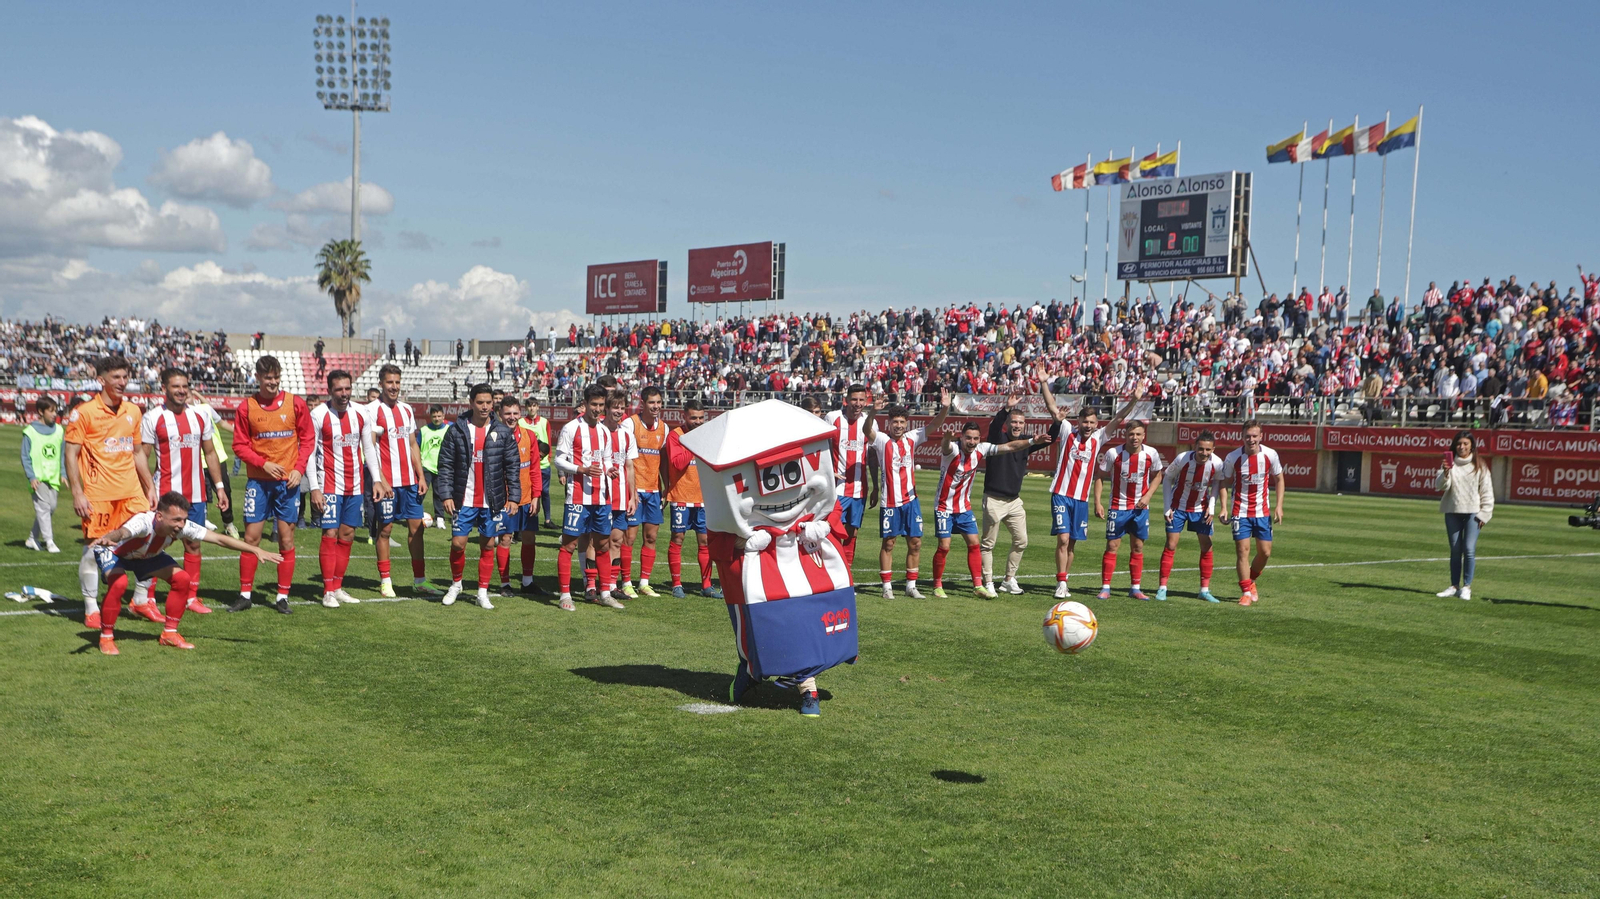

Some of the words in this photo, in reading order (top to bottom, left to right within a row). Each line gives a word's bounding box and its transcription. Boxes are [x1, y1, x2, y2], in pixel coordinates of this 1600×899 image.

[1127, 183, 1172, 198] Alonso
[1177, 178, 1224, 194] Alonso
[1144, 224, 1164, 232] LOCAL
[1181, 221, 1203, 230] VISITANTE
[1168, 232, 1176, 250] 2
[716, 260, 732, 268] Puerto
[1140, 261, 1174, 269] PERMOTOR
[1175, 258, 1212, 267] ALGECIRAS
[711, 268, 738, 279] Algeciras
[1170, 268, 1192, 276] OFICIAL
[594, 273, 616, 298] ICC
[965, 404, 1003, 412] ALGECIRA
[1268, 432, 1311, 442] PODOLOGÍA
[1341, 433, 1426, 447] CLÍNICAMUÑOZ
[1513, 437, 1600, 452] CLÍNICAMUÑ
[763, 461, 801, 491] 60
[1404, 466, 1437, 478] Ayunt
[1554, 468, 1600, 486] popu
[1410, 478, 1421, 488] de
[1517, 486, 1540, 496] CON
[1542, 488, 1554, 496] EL
[1556, 488, 1600, 498] DEPORT
[323, 504, 336, 518] 21
[382, 502, 394, 514] 15
[98, 513, 110, 527] 13
[568, 512, 580, 526] 17
[676, 512, 682, 524] 3
[882, 517, 890, 530] 6
[938, 518, 947, 530] 11
[1056, 514, 1063, 526] 8
[821, 608, 850, 636] 1909
